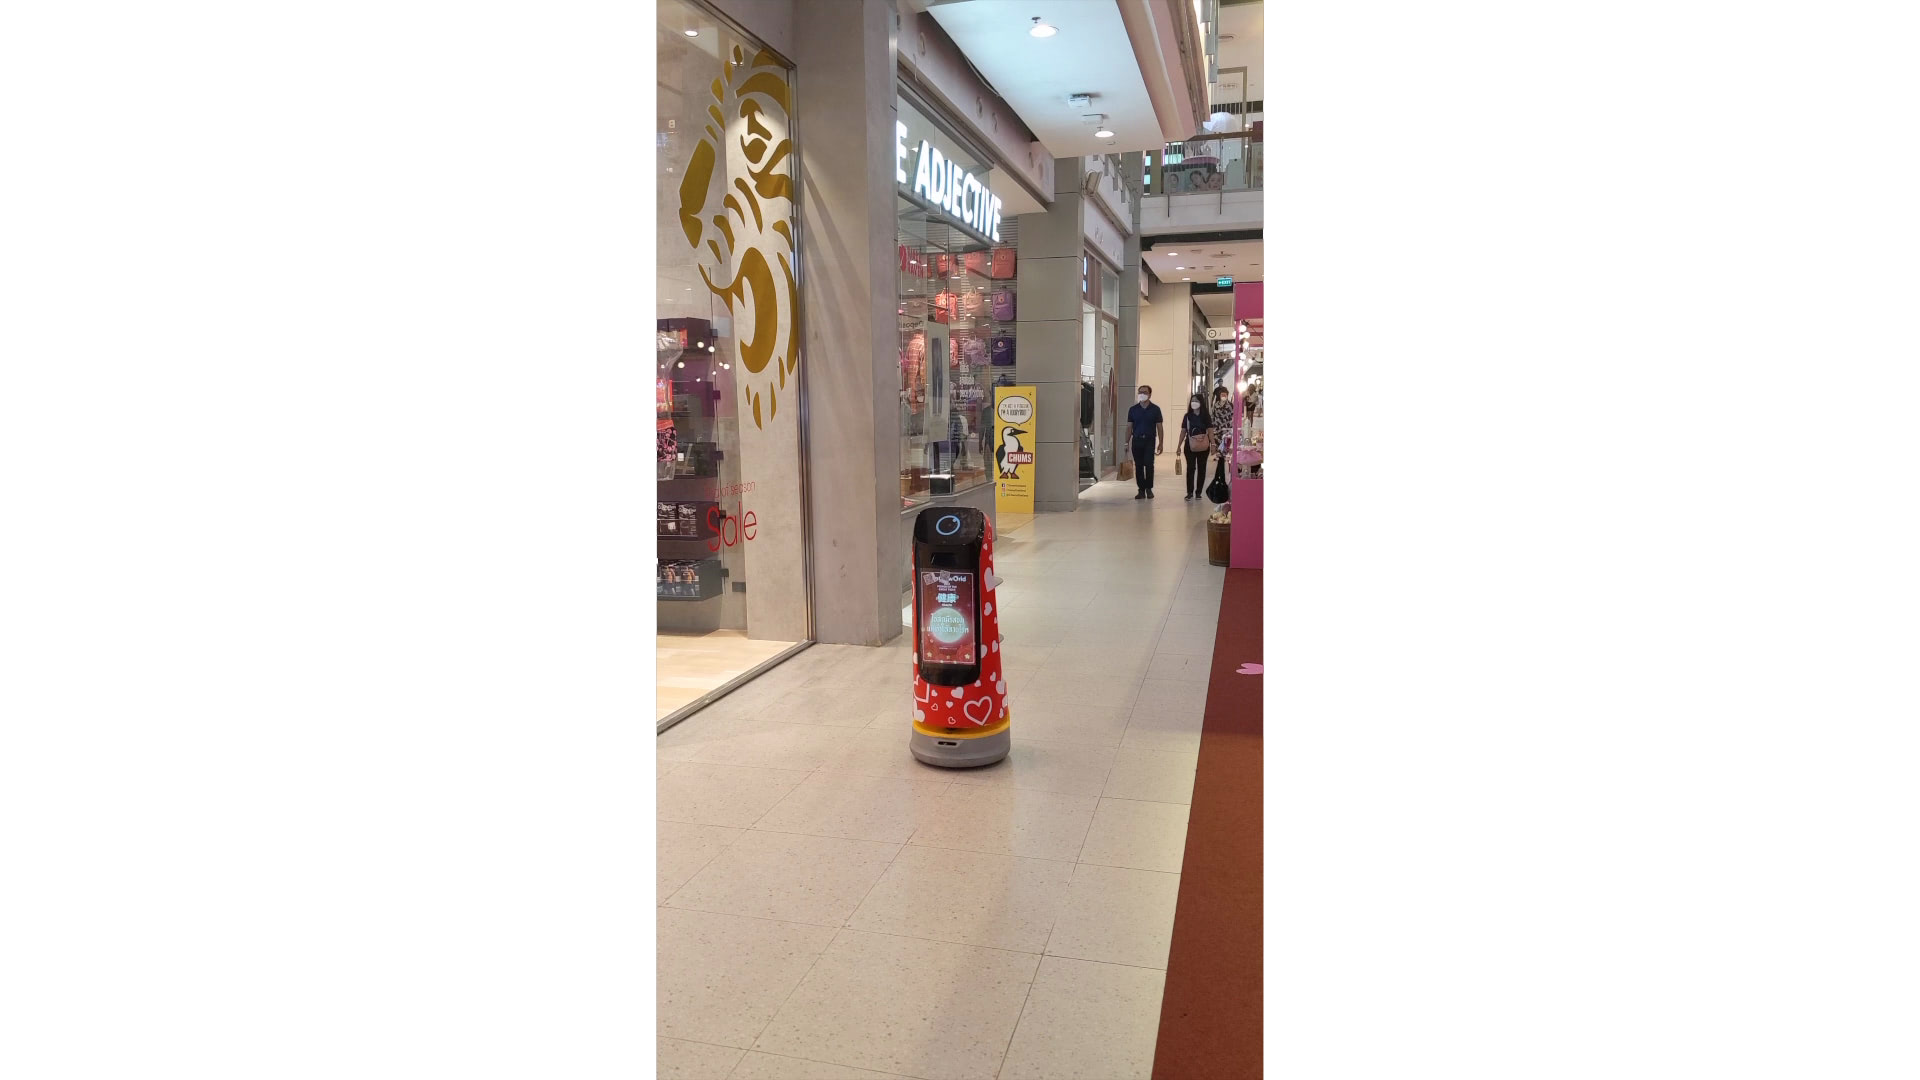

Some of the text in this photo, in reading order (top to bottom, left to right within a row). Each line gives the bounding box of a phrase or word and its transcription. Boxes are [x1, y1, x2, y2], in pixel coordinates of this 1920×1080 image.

[914, 139, 1002, 242] ADJECTIVE
[1008, 453, 1032, 463] CHUMS
[707, 501, 757, 552] Sale
